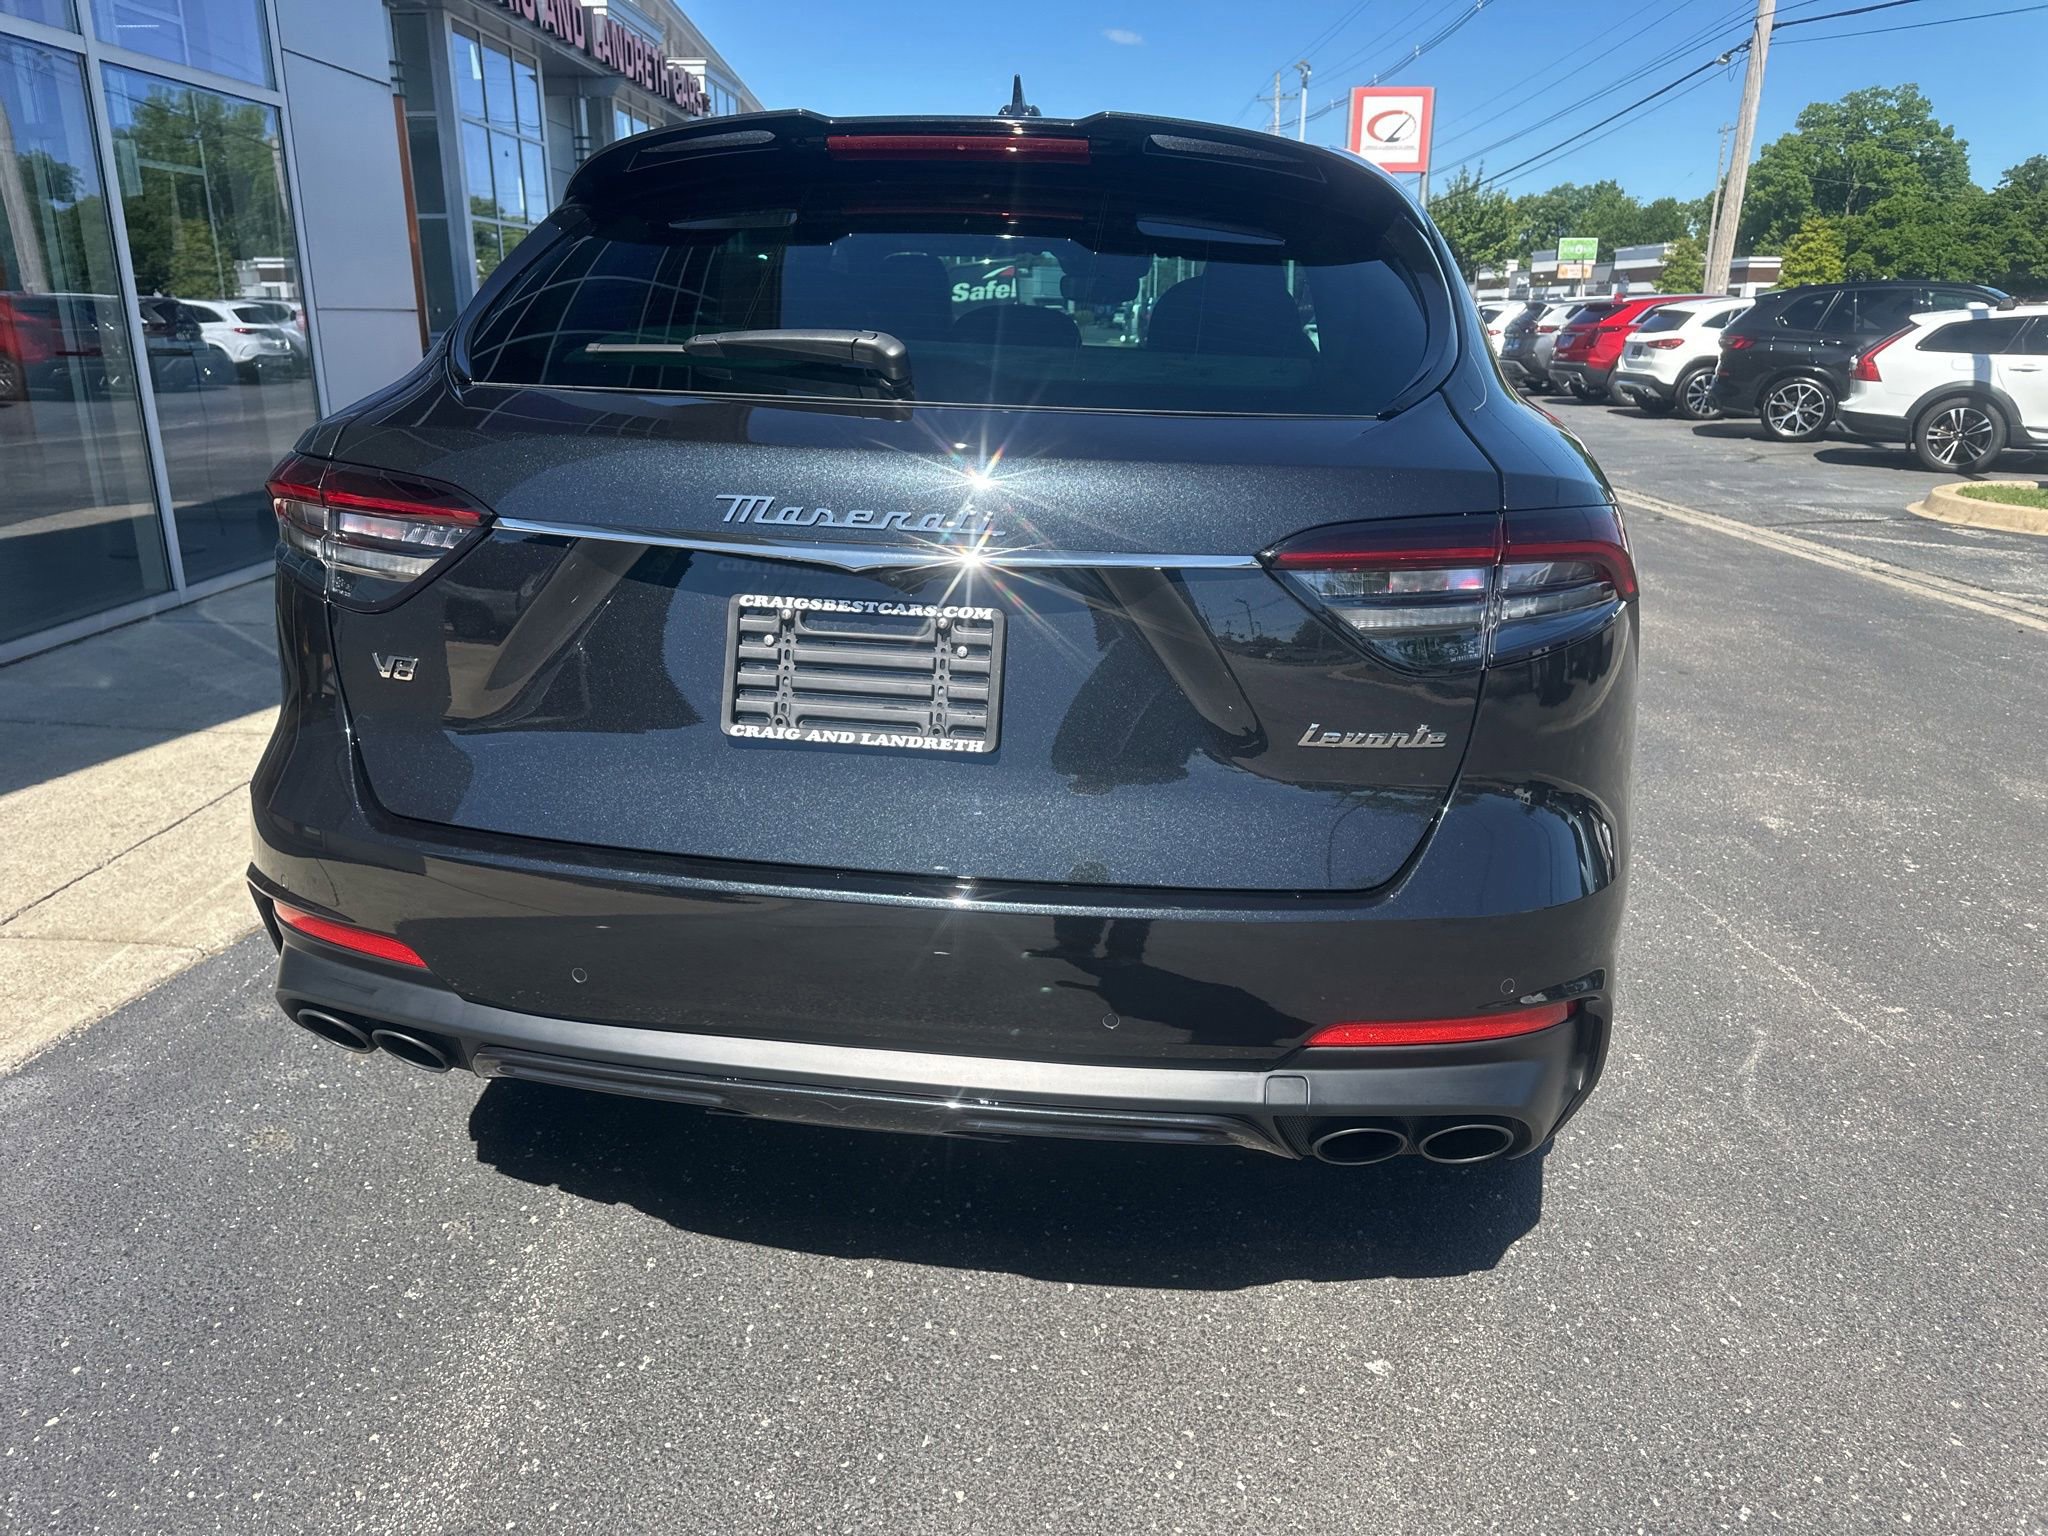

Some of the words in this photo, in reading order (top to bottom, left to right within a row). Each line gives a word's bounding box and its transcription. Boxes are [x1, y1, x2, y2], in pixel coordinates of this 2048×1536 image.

[540, 0, 585, 49] AND
[592, 9, 670, 99] LANDRETH
[715, 494, 1007, 537] Maserati
[739, 594, 994, 620] CRAIGSBESTCARS.COM
[729, 724, 801, 740] CRAIG
[805, 729, 856, 744] AND
[860, 733, 985, 753] LANDRETH
[1298, 723, 1447, 749] Levante
